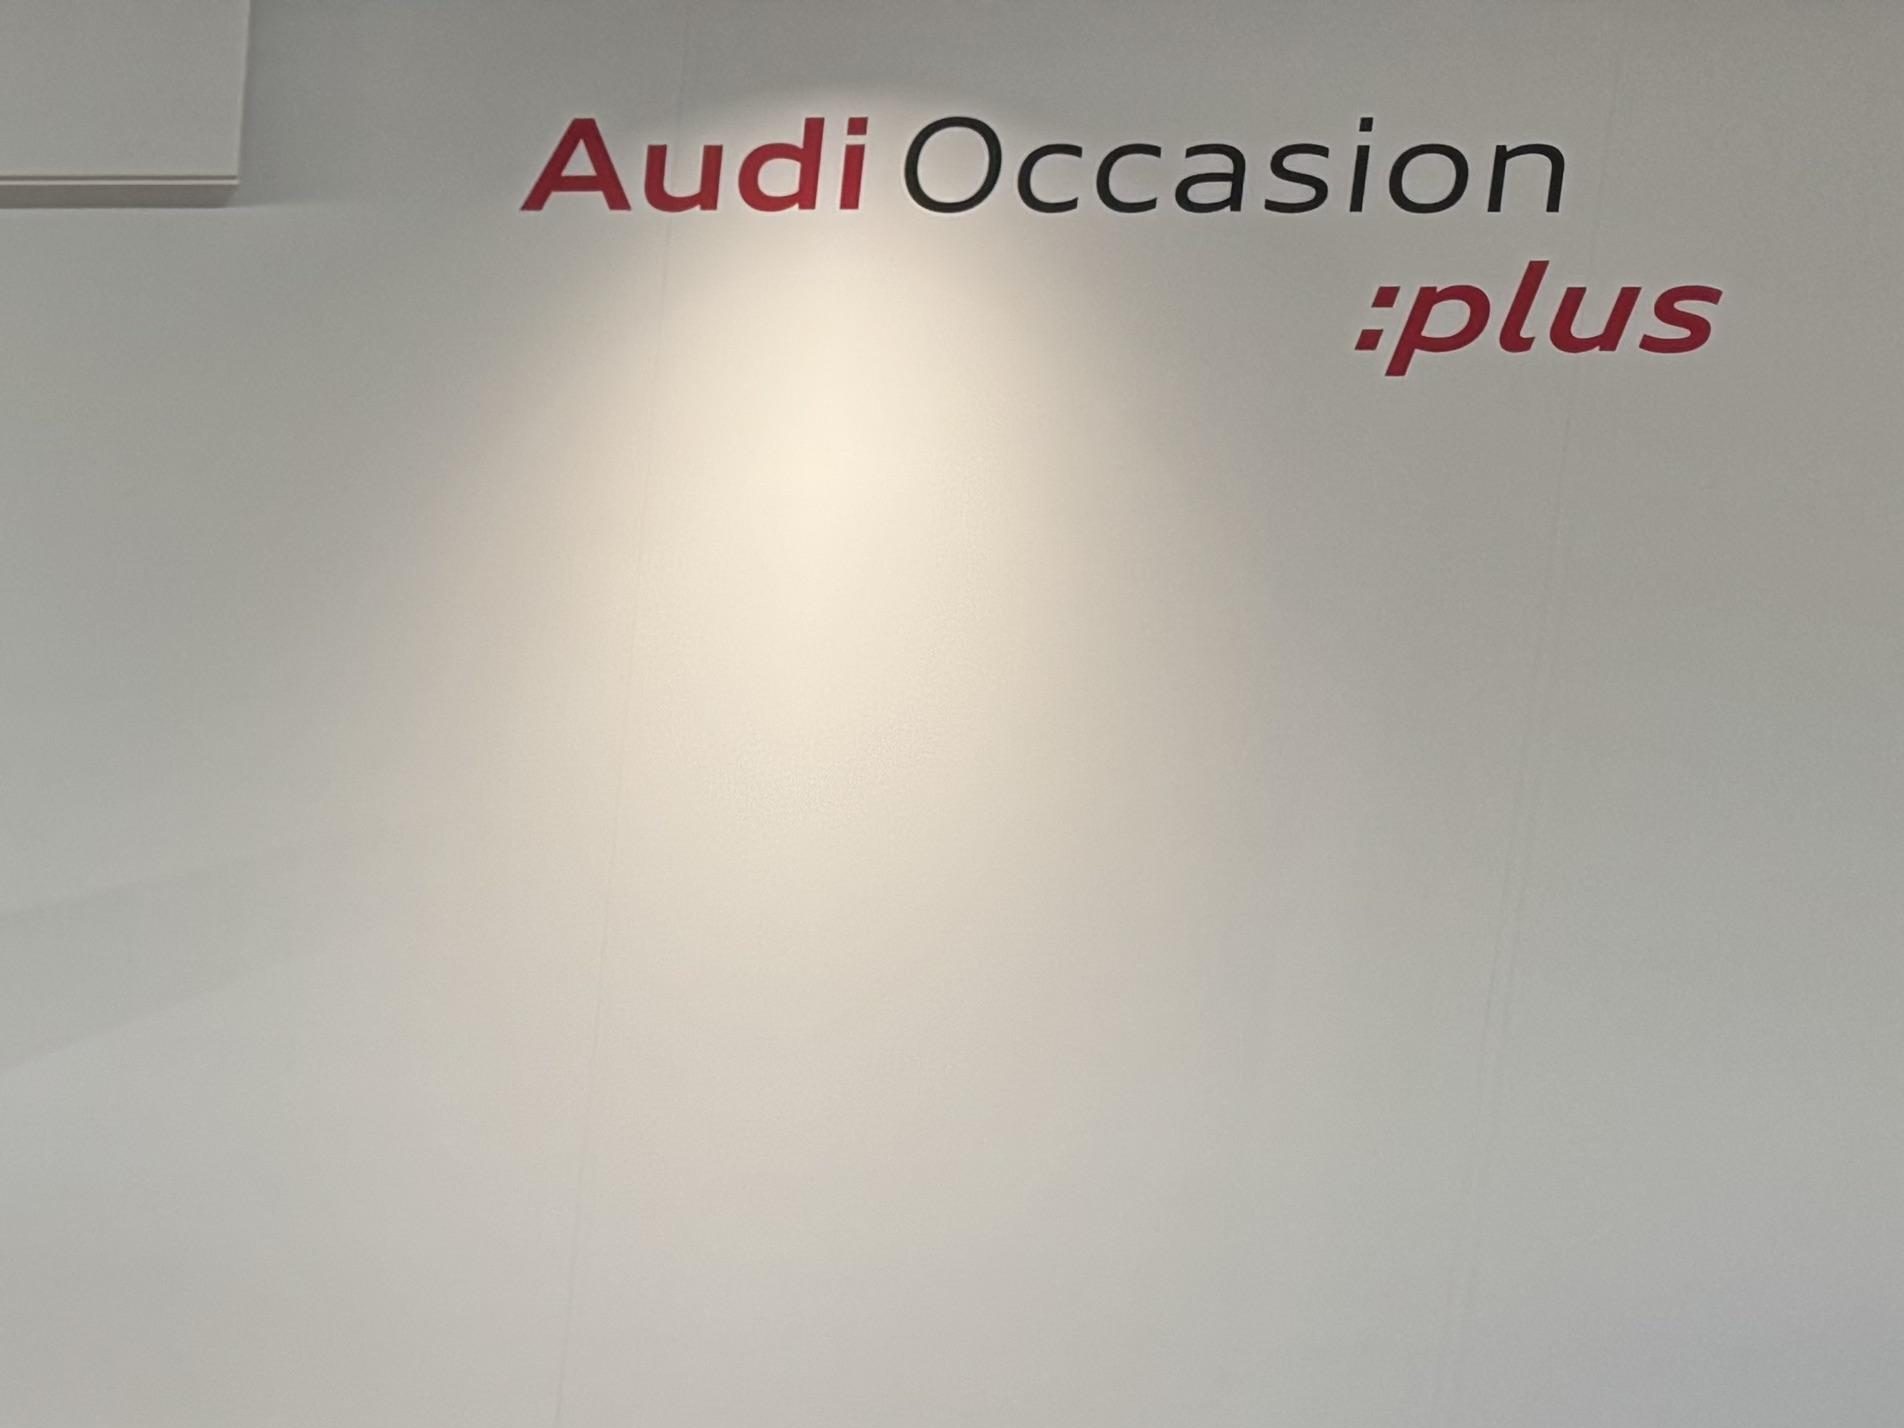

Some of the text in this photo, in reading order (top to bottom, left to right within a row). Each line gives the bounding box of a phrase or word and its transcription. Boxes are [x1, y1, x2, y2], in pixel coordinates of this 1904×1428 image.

[523, 115, 1566, 215] Audi Occasion
[1356, 259, 1723, 378] :plus
